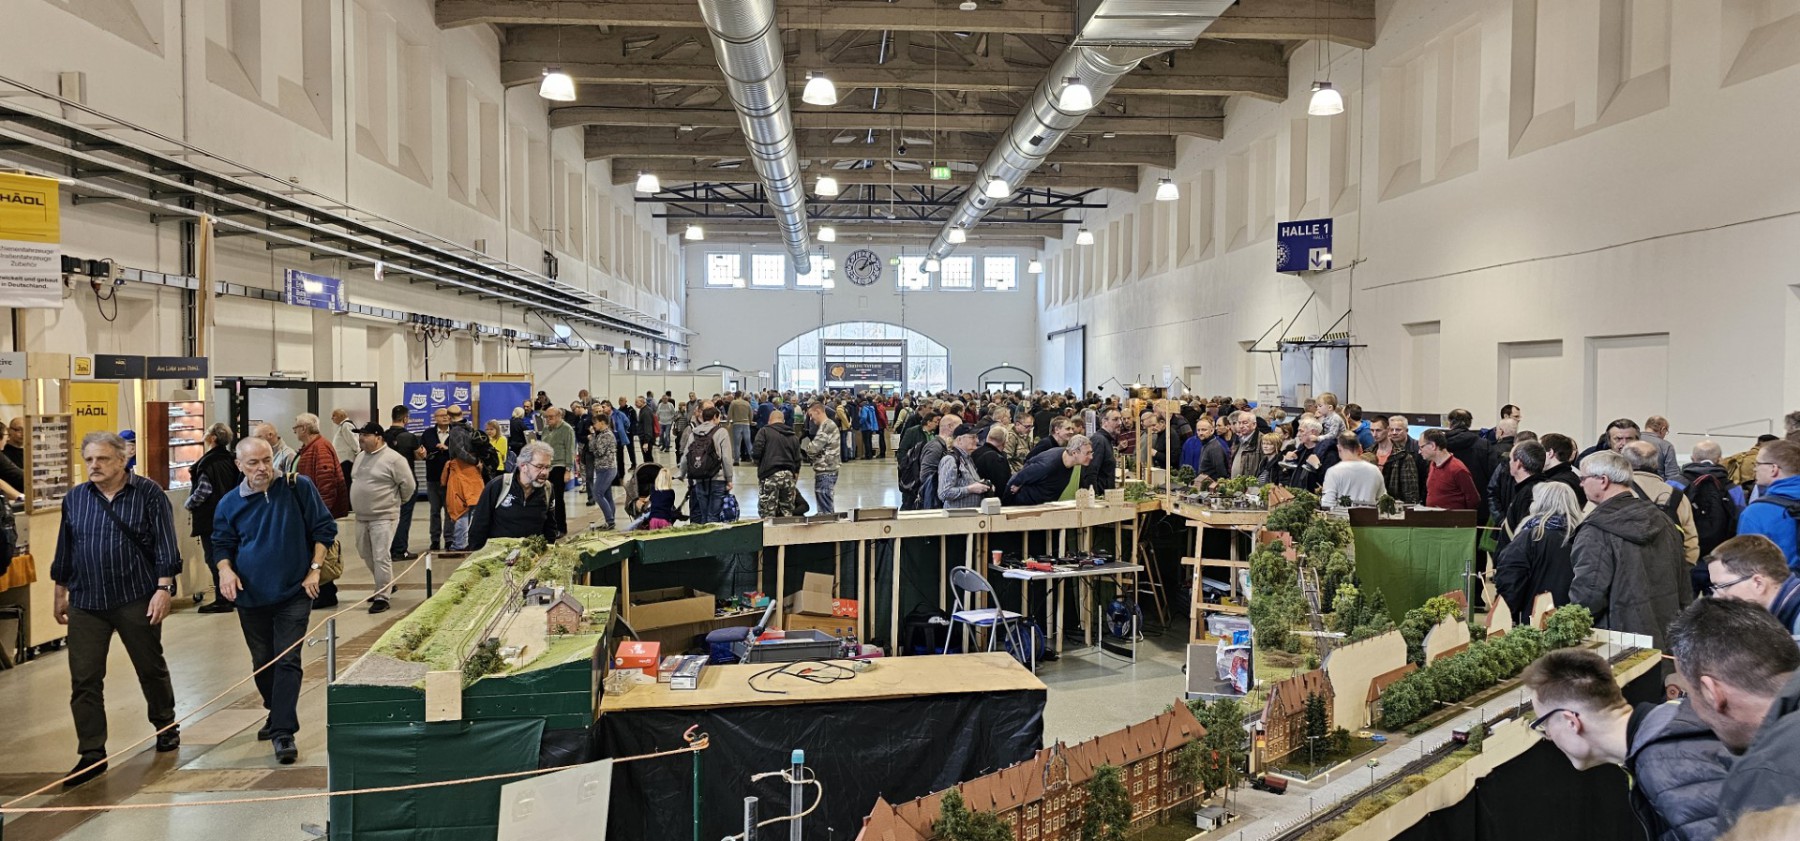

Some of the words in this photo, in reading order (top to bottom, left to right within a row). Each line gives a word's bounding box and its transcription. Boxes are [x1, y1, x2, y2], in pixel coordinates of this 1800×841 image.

[1282, 224, 1320, 237] HALLE
[1323, 223, 1329, 234] 1
[76, 404, 107, 416] HÄDL
